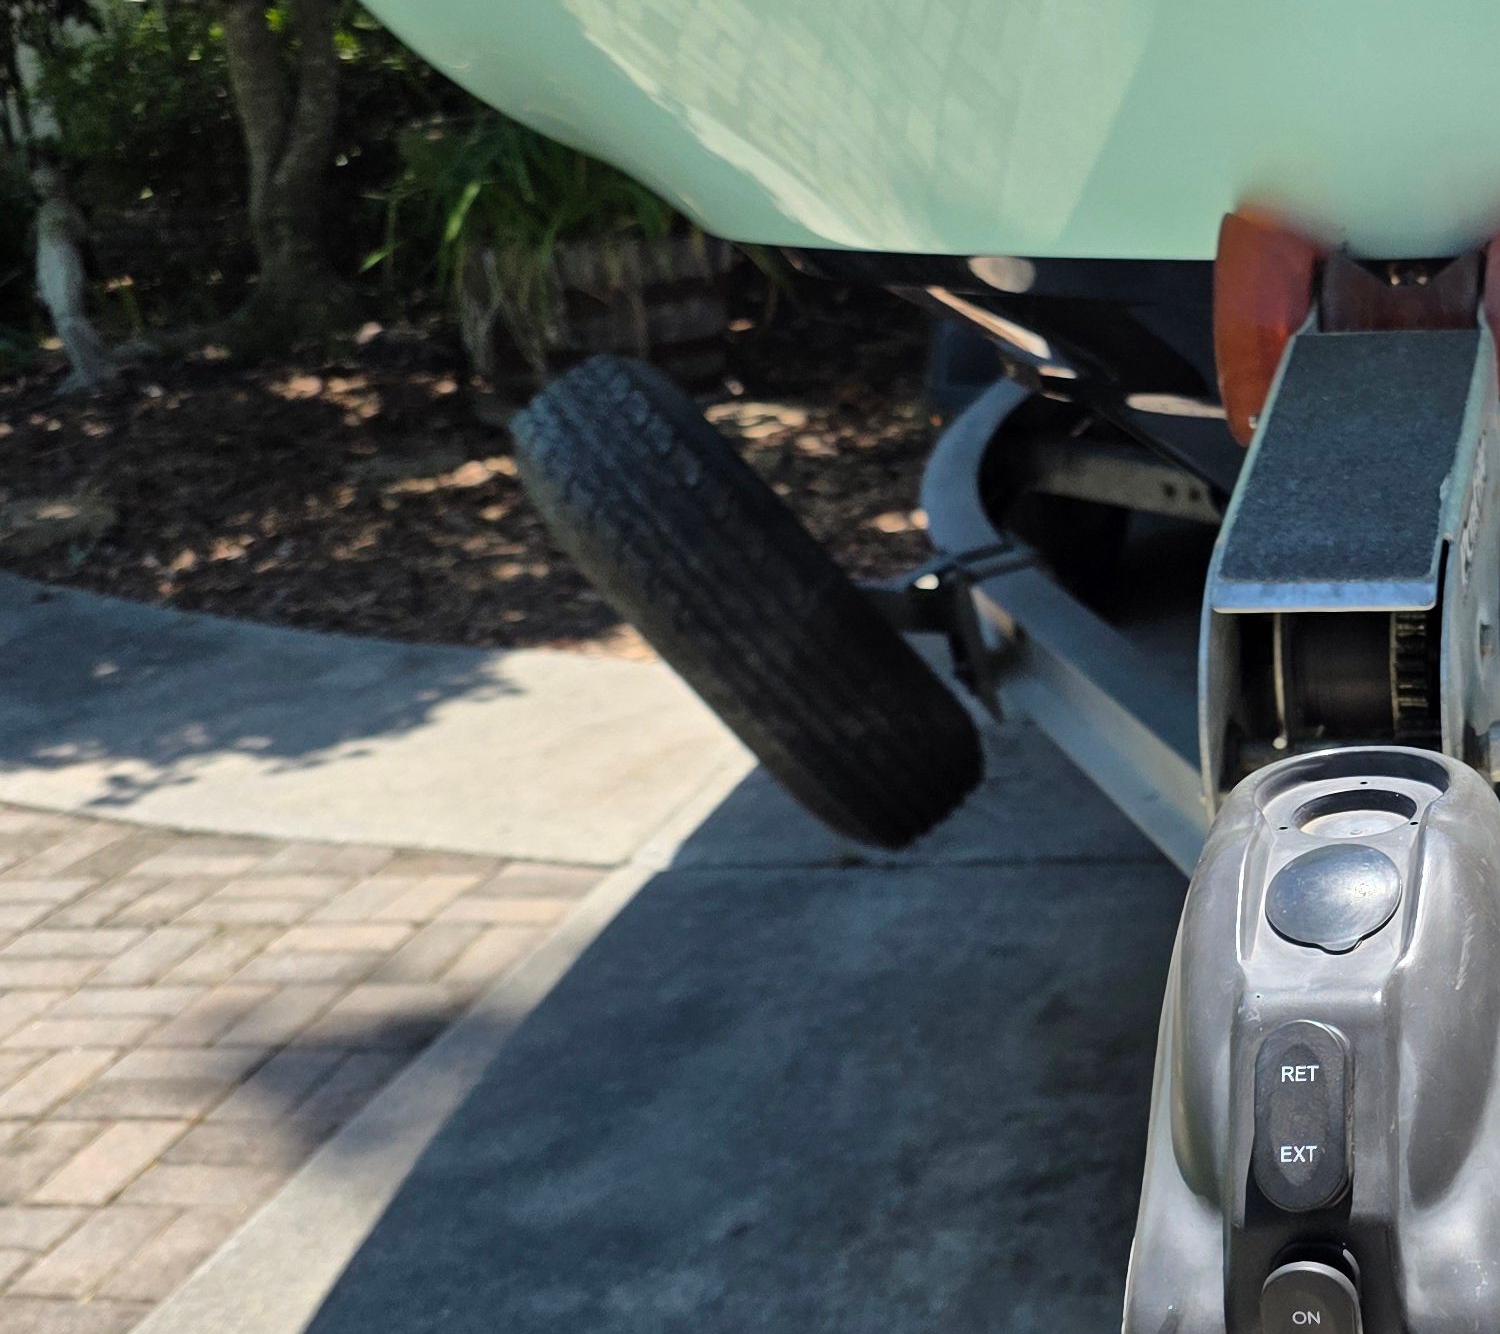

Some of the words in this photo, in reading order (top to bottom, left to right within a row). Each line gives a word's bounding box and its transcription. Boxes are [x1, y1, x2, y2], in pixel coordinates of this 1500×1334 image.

[1281, 1064, 1320, 1083] RET
[1280, 1145, 1318, 1164] EXT
[1291, 1310, 1322, 1326] ON
